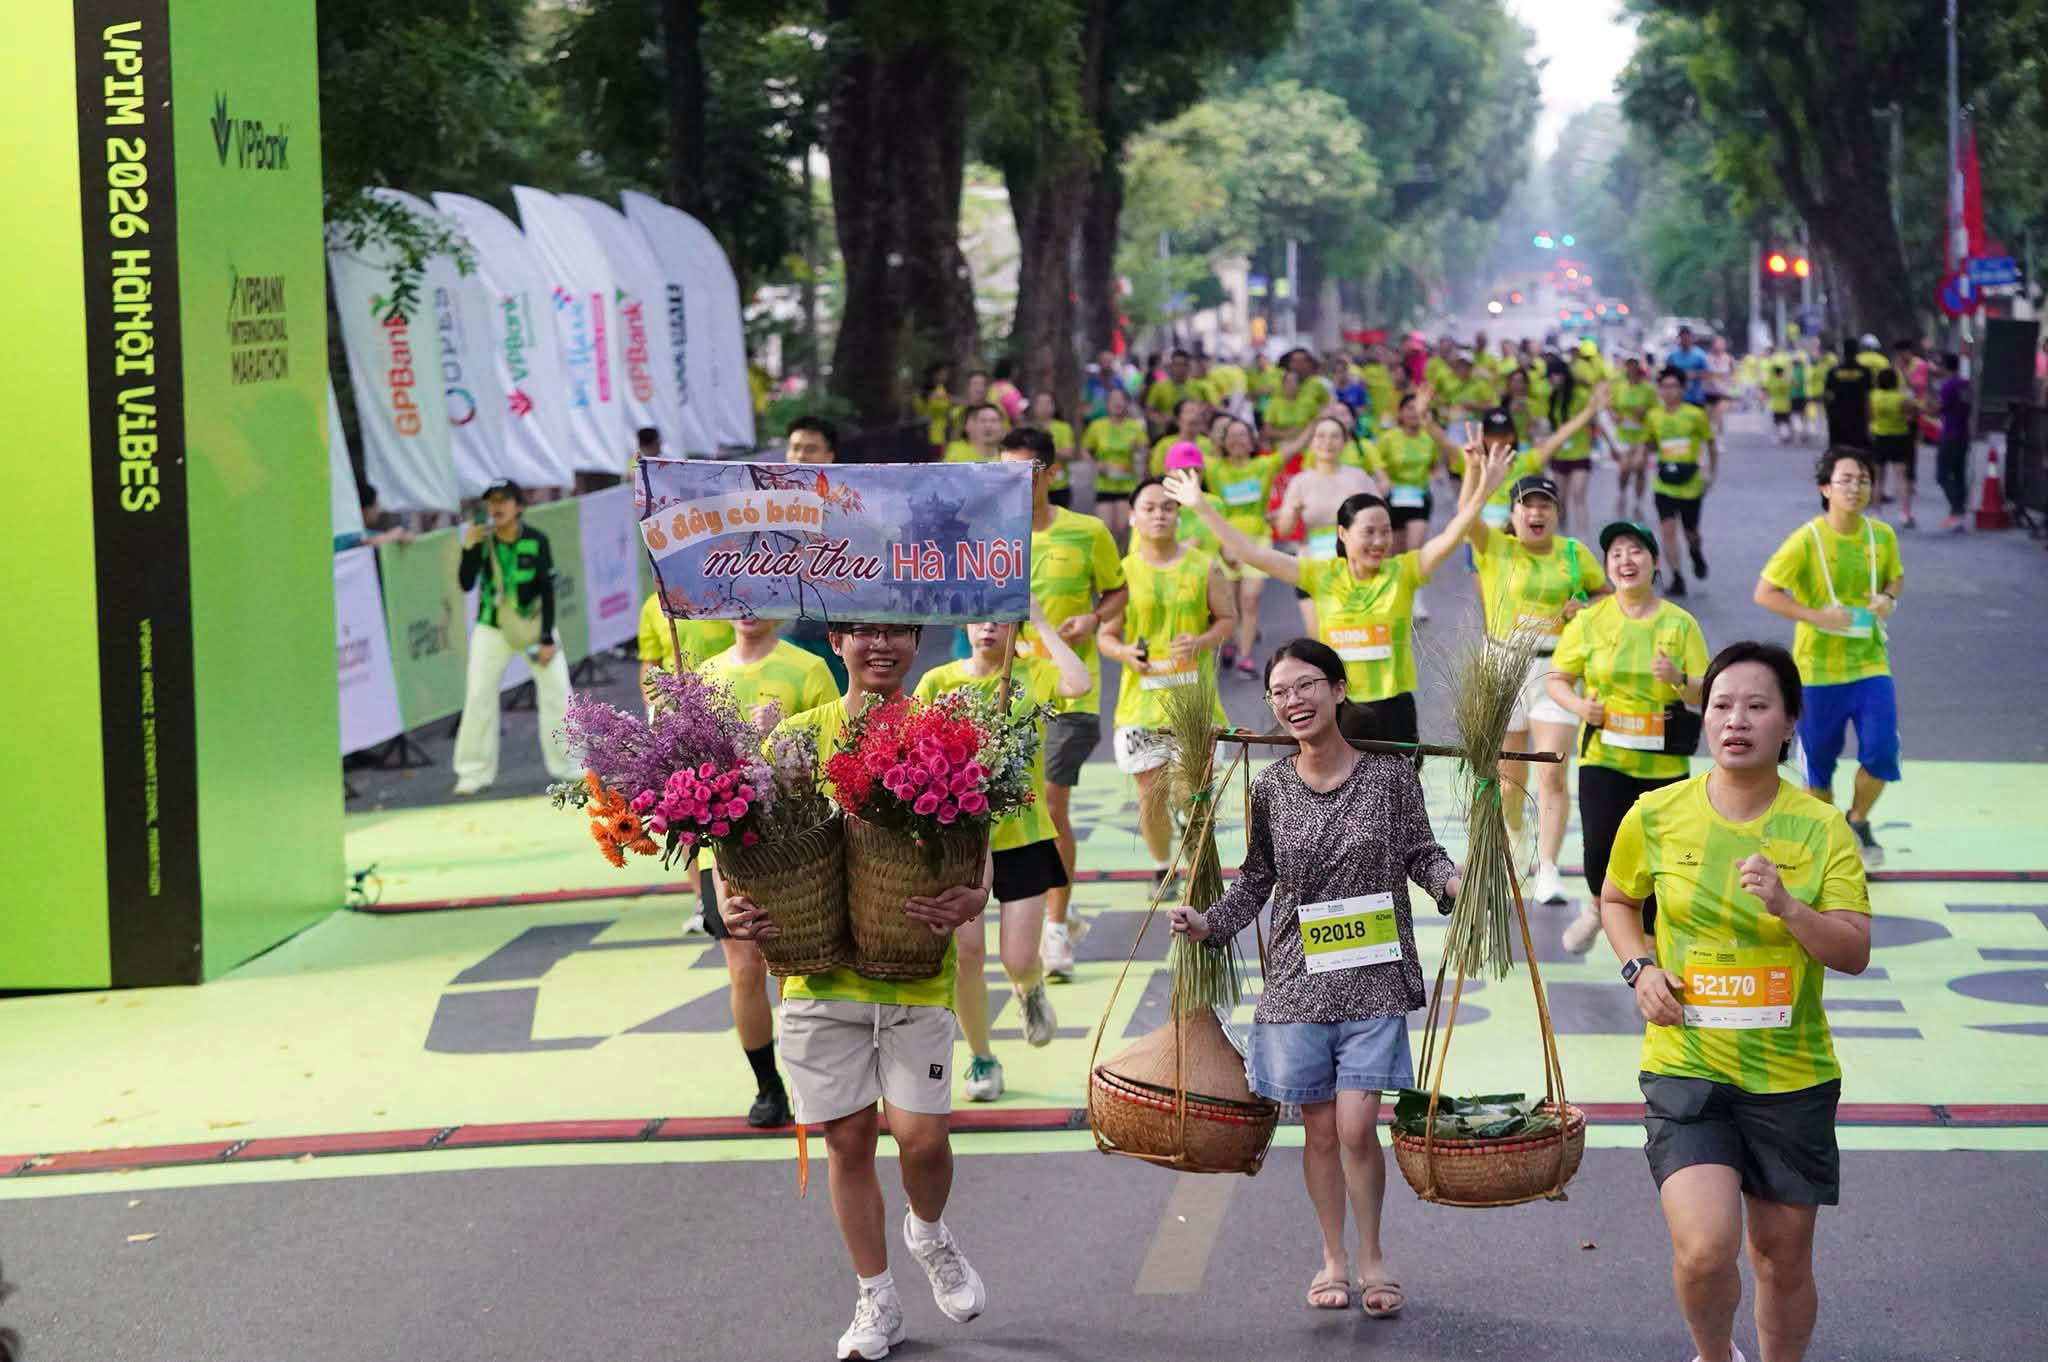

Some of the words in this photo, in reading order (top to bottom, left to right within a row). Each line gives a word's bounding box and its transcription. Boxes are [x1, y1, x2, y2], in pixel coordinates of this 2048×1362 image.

[104, 20, 145, 126] VPIM
[234, 119, 289, 171] VPBank
[106, 137, 151, 239] 2026
[502, 298, 528, 382] VPBank
[622, 301, 654, 403] GPBank
[231, 348, 289, 385] MARATHON
[671, 507, 725, 535] đây
[727, 498, 760, 525] có
[766, 497, 819, 525] bán
[704, 539, 801, 578] mùa
[803, 539, 885, 580] thu
[892, 540, 946, 582] Hà
[957, 538, 1024, 588] Nội
[1309, 920, 1366, 945] 92018
[1692, 973, 1756, 996] 52170
